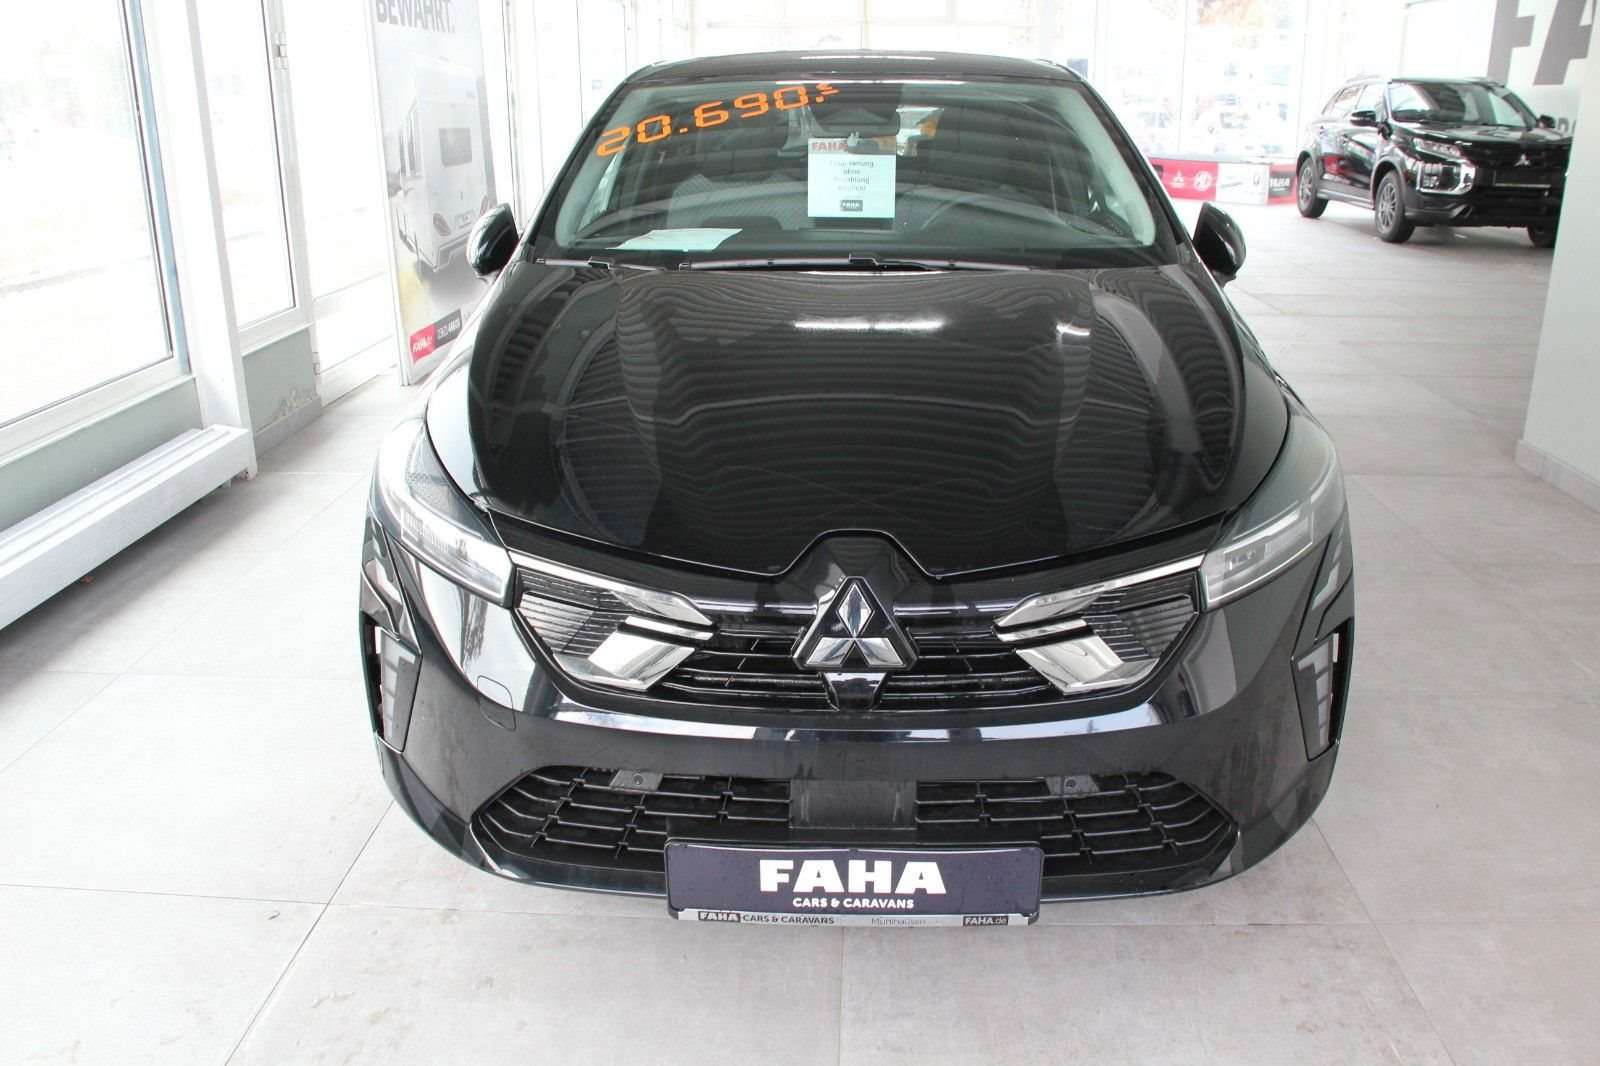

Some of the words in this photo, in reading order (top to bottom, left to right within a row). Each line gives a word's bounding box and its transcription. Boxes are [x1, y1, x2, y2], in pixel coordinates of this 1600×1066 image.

[760, 860, 946, 894] FAHA
[792, 897, 828, 908] CARS
[831, 897, 840, 908] &
[843, 898, 914, 909] CARAVANS
[699, 911, 738, 921] FAHA
[743, 914, 769, 923] CARS
[770, 915, 779, 923] &
[781, 915, 834, 925] CARAVANS
[965, 916, 1007, 926] FAHA.de
